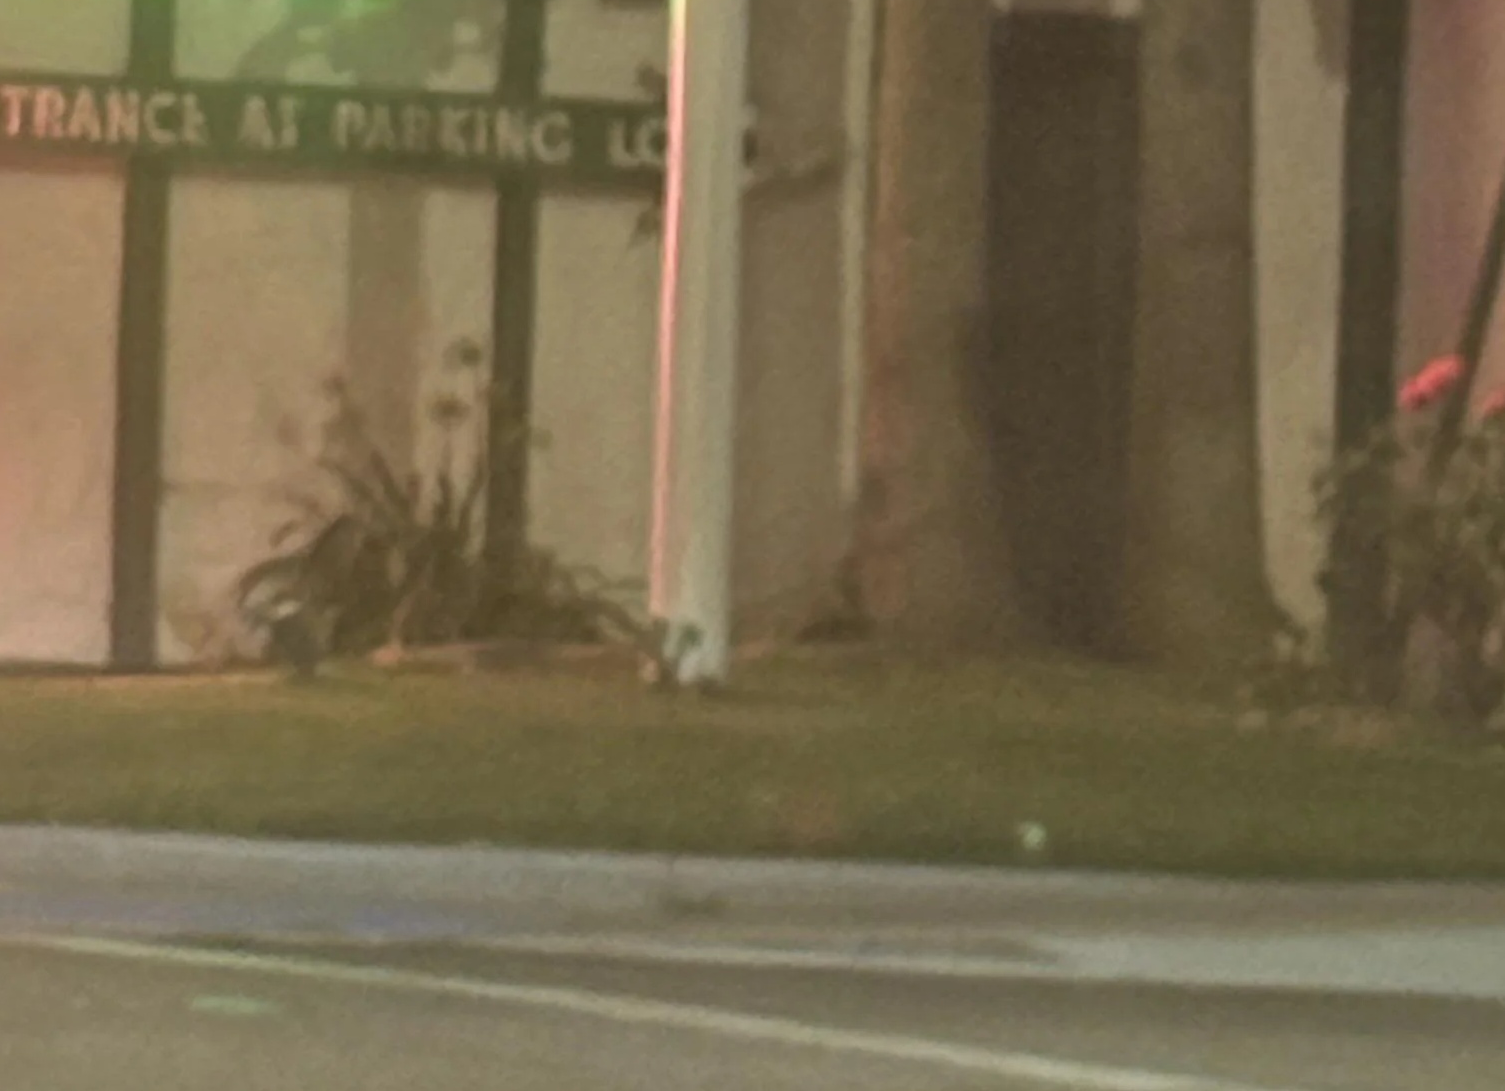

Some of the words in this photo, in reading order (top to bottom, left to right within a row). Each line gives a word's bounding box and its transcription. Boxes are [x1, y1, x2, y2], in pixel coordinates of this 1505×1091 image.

[237, 93, 303, 149] AT
[330, 99, 573, 165] PARKING
[607, 117, 669, 168] LO
